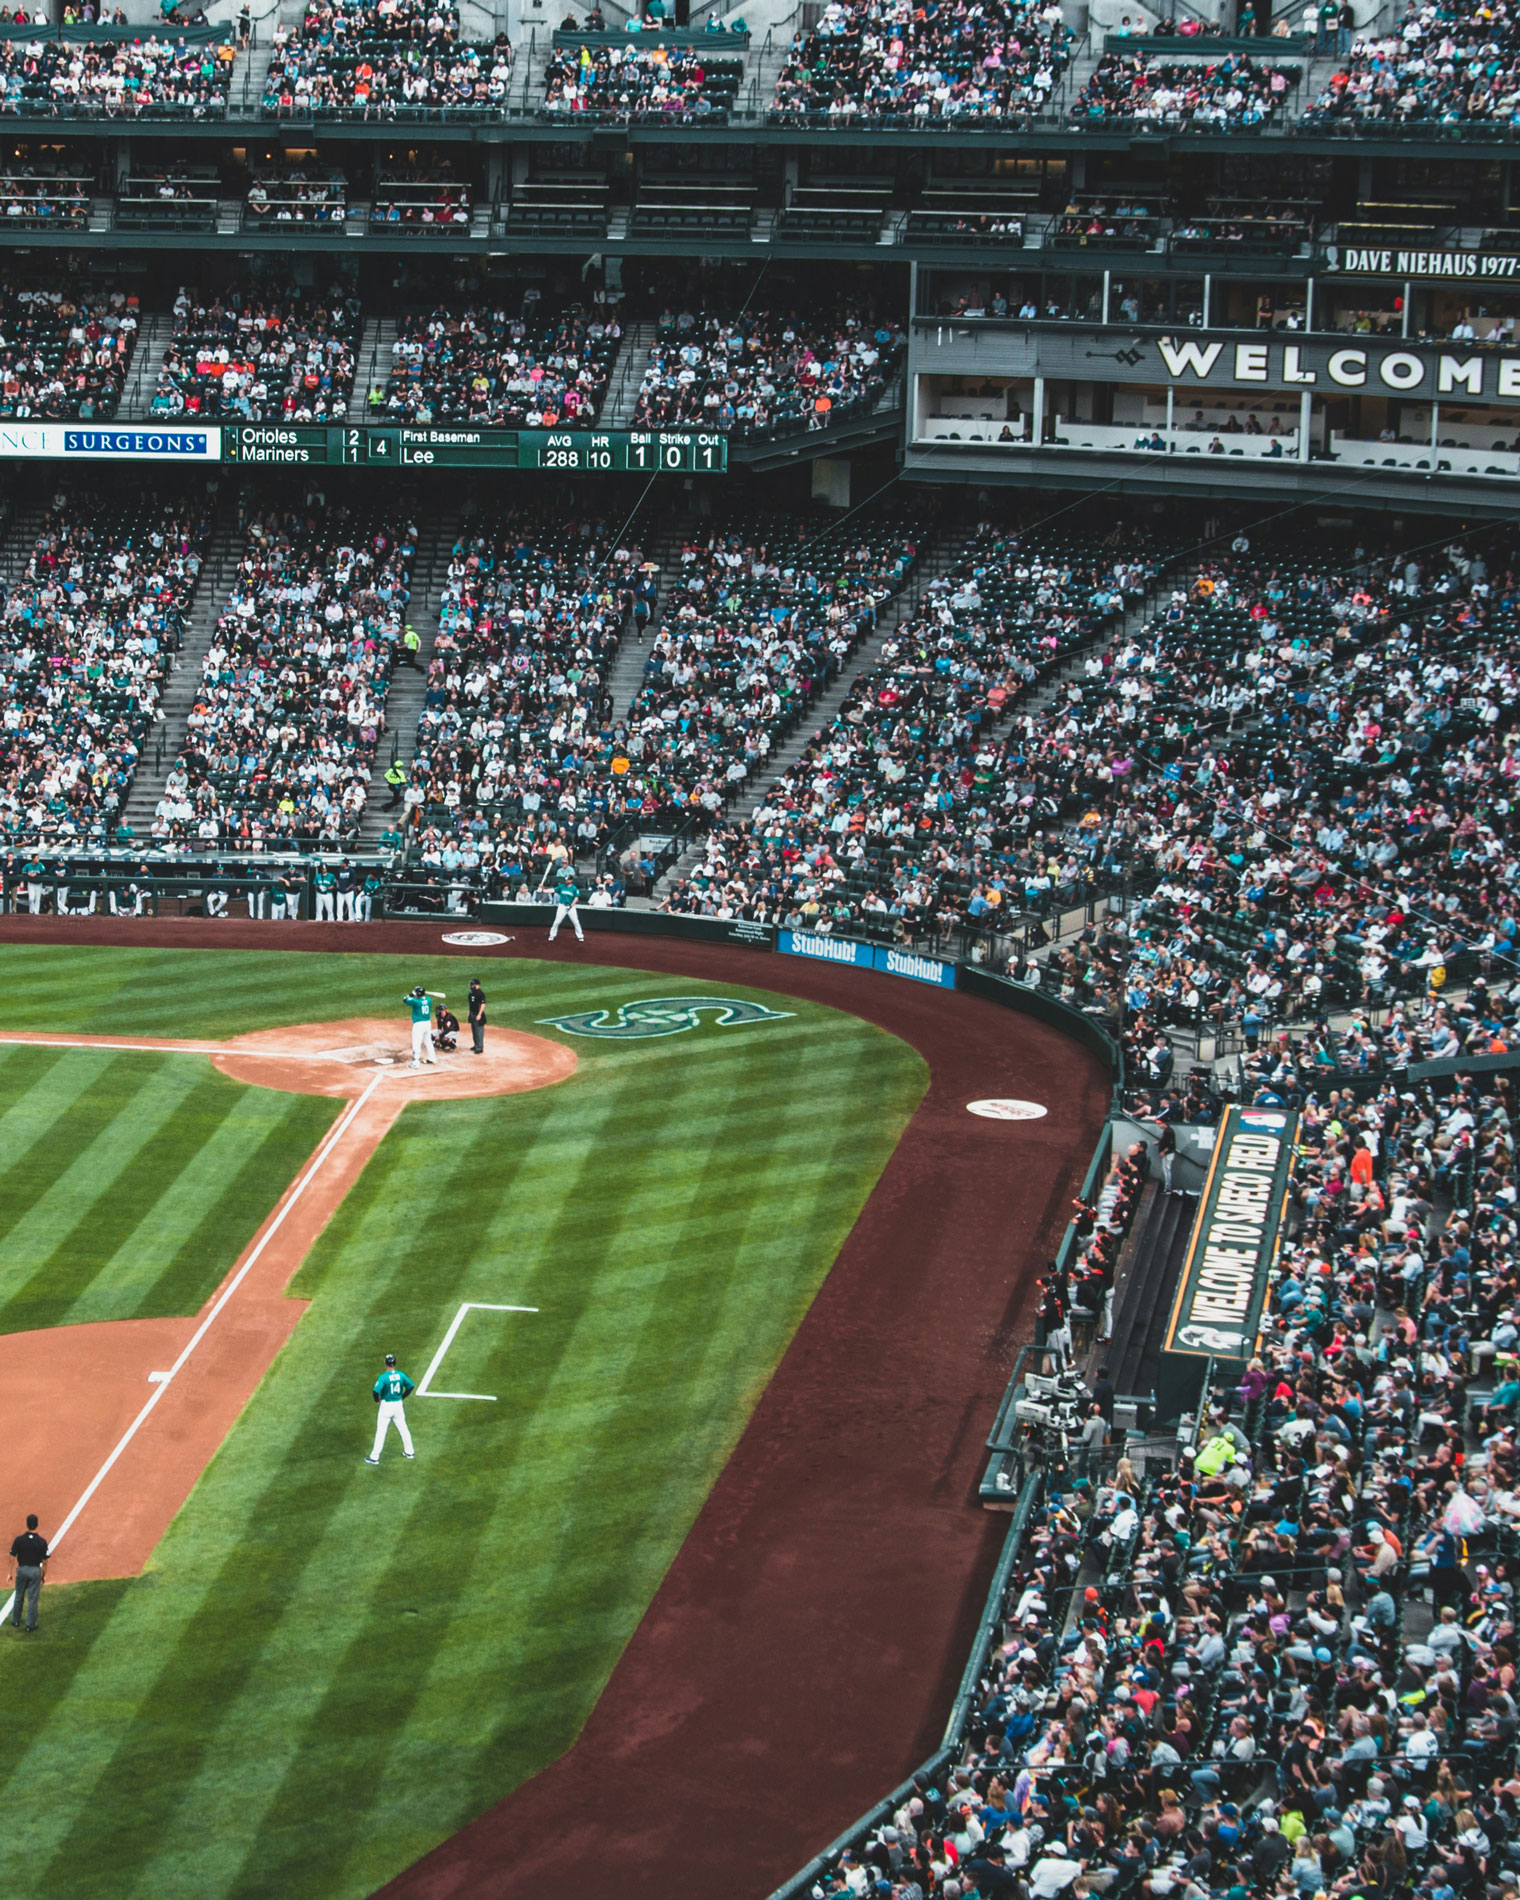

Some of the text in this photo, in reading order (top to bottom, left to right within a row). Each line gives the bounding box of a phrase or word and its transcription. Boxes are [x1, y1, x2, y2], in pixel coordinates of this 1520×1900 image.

[1345, 249, 1391, 272] DAVE
[1397, 251, 1477, 276] NIEHAUS
[1157, 340, 1520, 396] WELCOME
[68, 434, 195, 452] SURGEONS
[242, 428, 359, 445] Orioles 2
[403, 431, 480, 444] First Baseman
[547, 435, 609, 448] AVG HR
[630, 433, 719, 446] Ball Strike Out
[242, 445, 357, 463] Mariners 1
[376, 440, 387, 455] 4
[403, 448, 434, 464] Lee
[541, 451, 611, 468] .288 10
[637, 446, 712, 469] 1 0 1
[792, 932, 856, 963] StubHub!
[886, 950, 943, 983] StubHub!
[1190, 1133, 1281, 1324] WELCOME TO SAFECO FIELD
[390, 1382, 401, 1395] 14
[1211, 1441, 1225, 1452] 31
